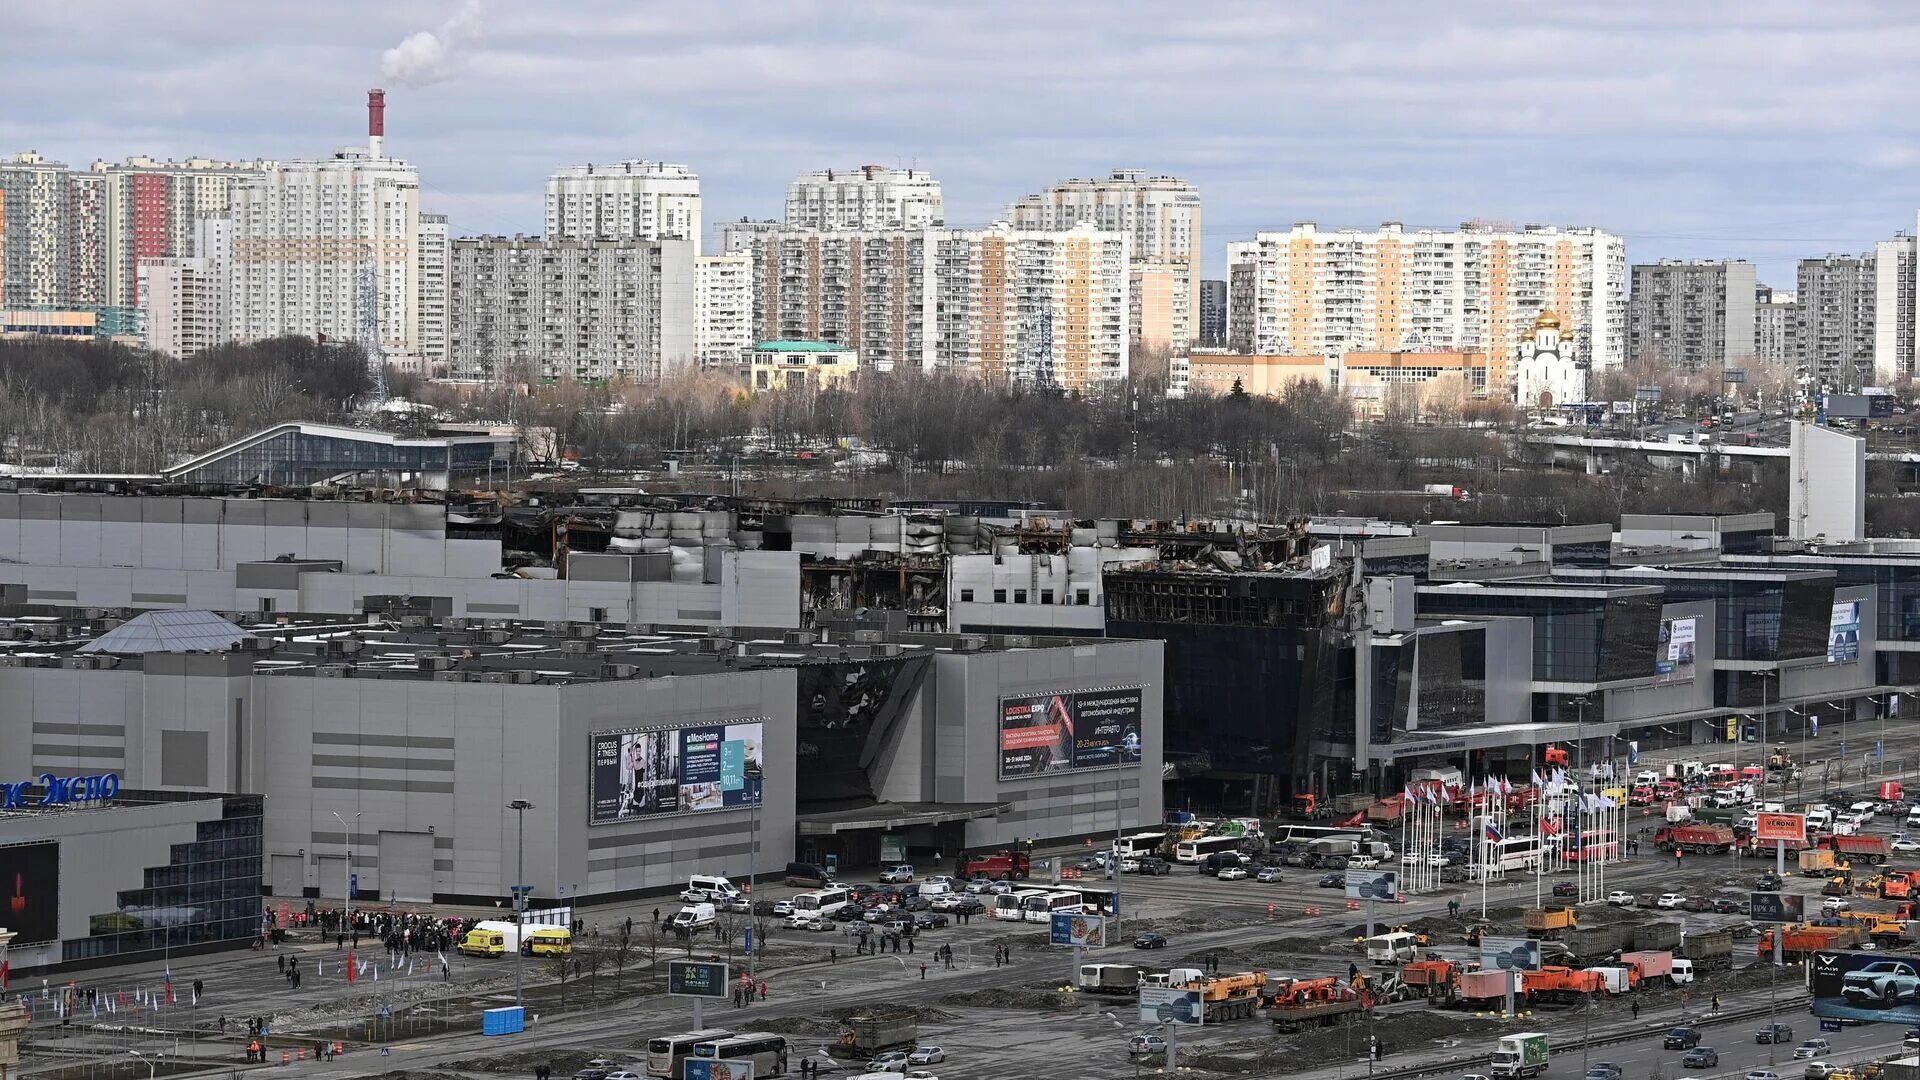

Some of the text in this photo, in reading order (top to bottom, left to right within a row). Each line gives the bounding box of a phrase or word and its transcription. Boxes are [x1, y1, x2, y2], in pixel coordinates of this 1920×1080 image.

[1005, 704, 1044, 715] LOGISTIKA EXPO
[691, 732, 718, 742] MosHome
[597, 741, 617, 750] CROCUS
[597, 756, 617, 766] ПЕРВЫЙ
[722, 761, 727, 771] 2
